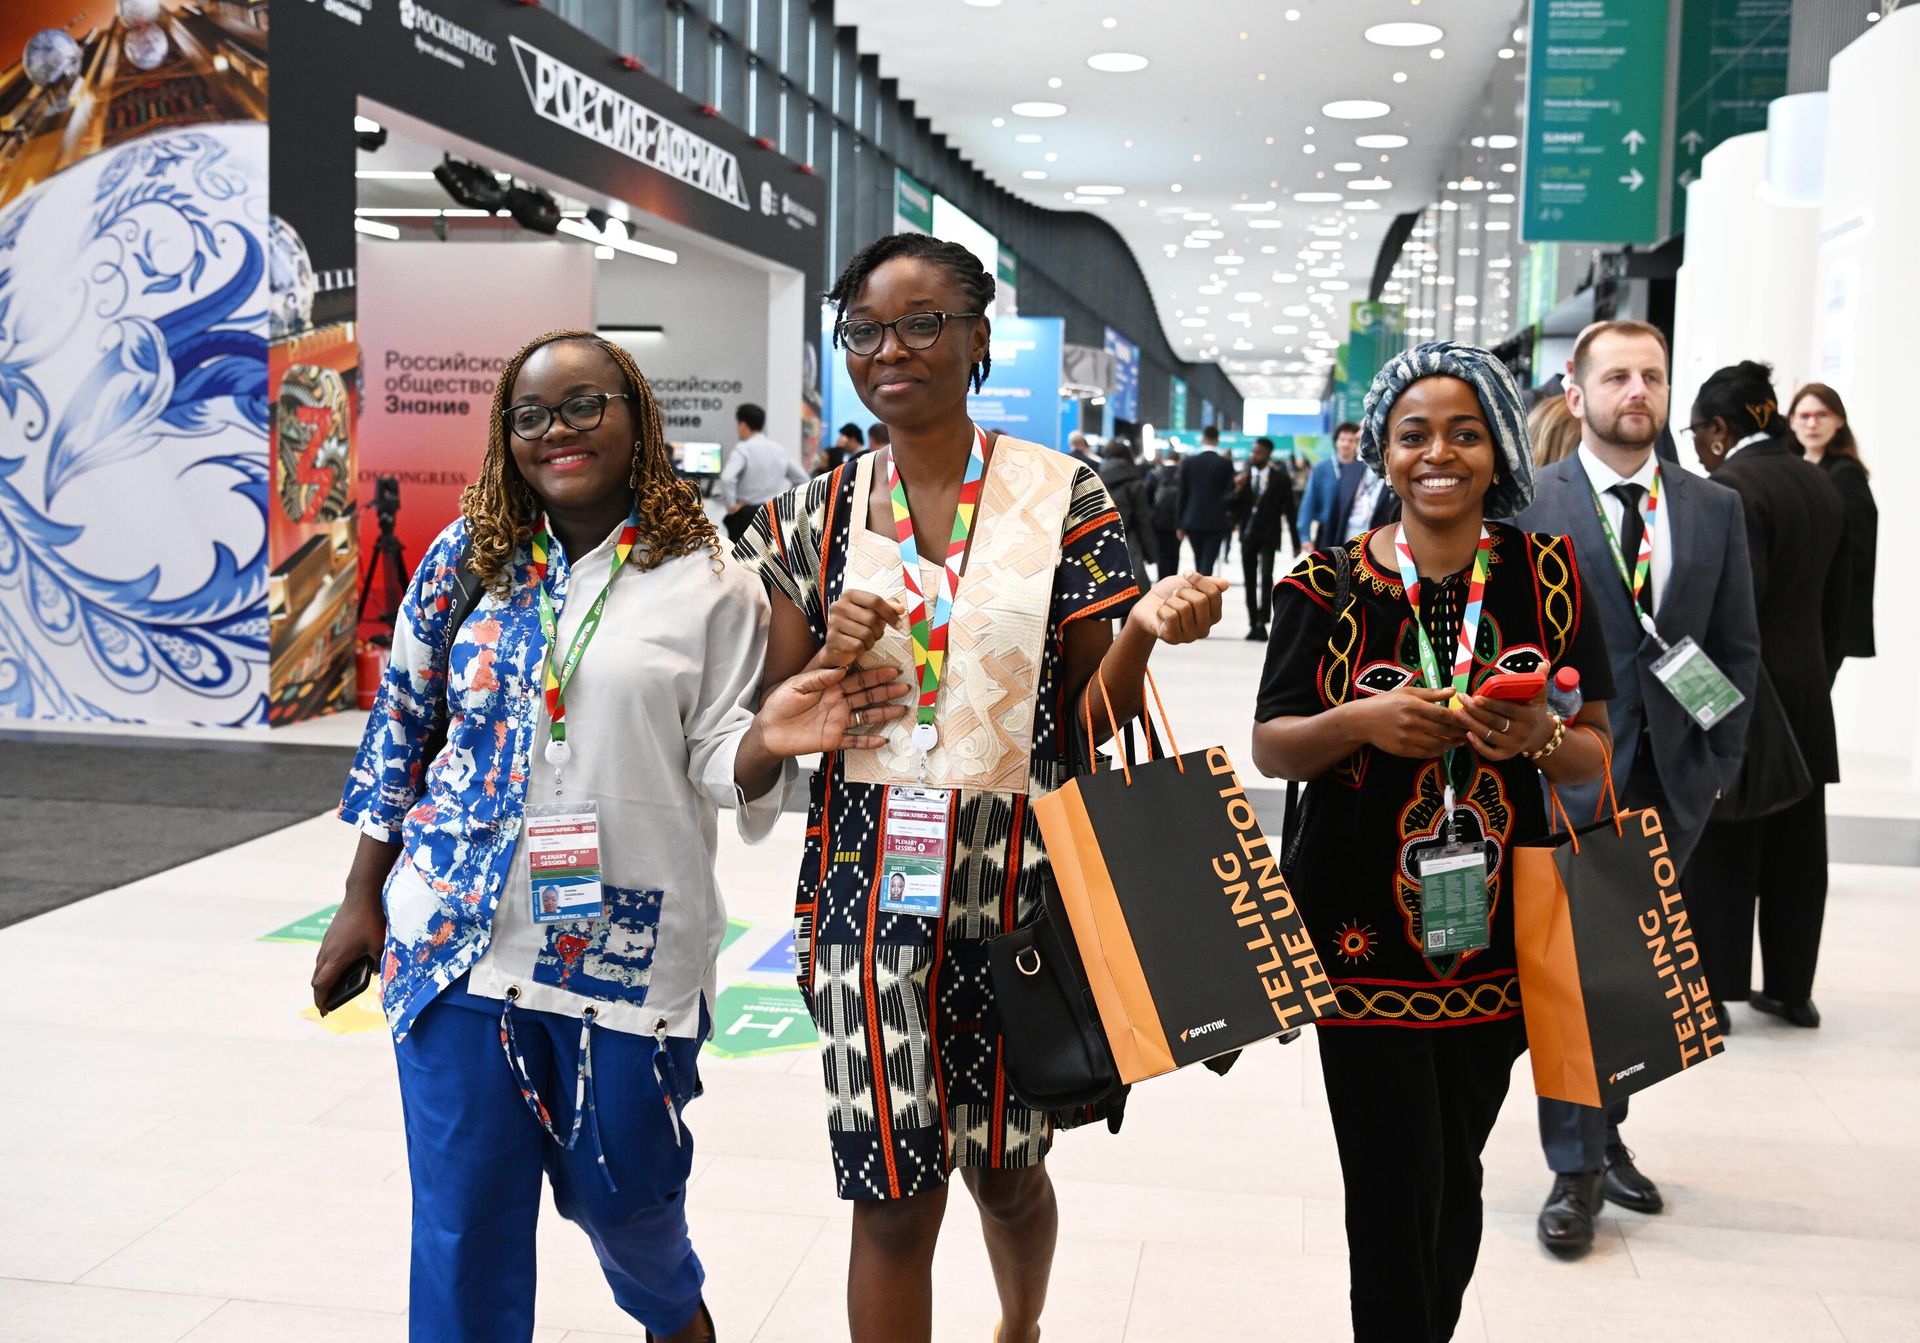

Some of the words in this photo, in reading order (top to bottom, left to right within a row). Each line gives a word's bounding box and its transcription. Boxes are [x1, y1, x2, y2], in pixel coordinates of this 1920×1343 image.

[385, 351, 511, 374] Российско
[385, 374, 496, 396] общество
[646, 376, 743, 394] оссийское
[385, 394, 470, 416] Знание
[357, 469, 467, 485] OSCONGRESS
[895, 838, 918, 846] PLENARY
[1205, 747, 1296, 921] UNTOLD
[1640, 807, 1700, 971] UNTOLD
[1212, 852, 1303, 1030] TELLING
[1280, 927, 1337, 1018] THE
[1638, 908, 1700, 1070] TELLING
[724, 1013, 795, 1039] H
[1687, 975, 1724, 1058] THE
[1188, 1018, 1228, 1039] SPUTNIK
[1615, 1061, 1646, 1081] SPUTNIK
